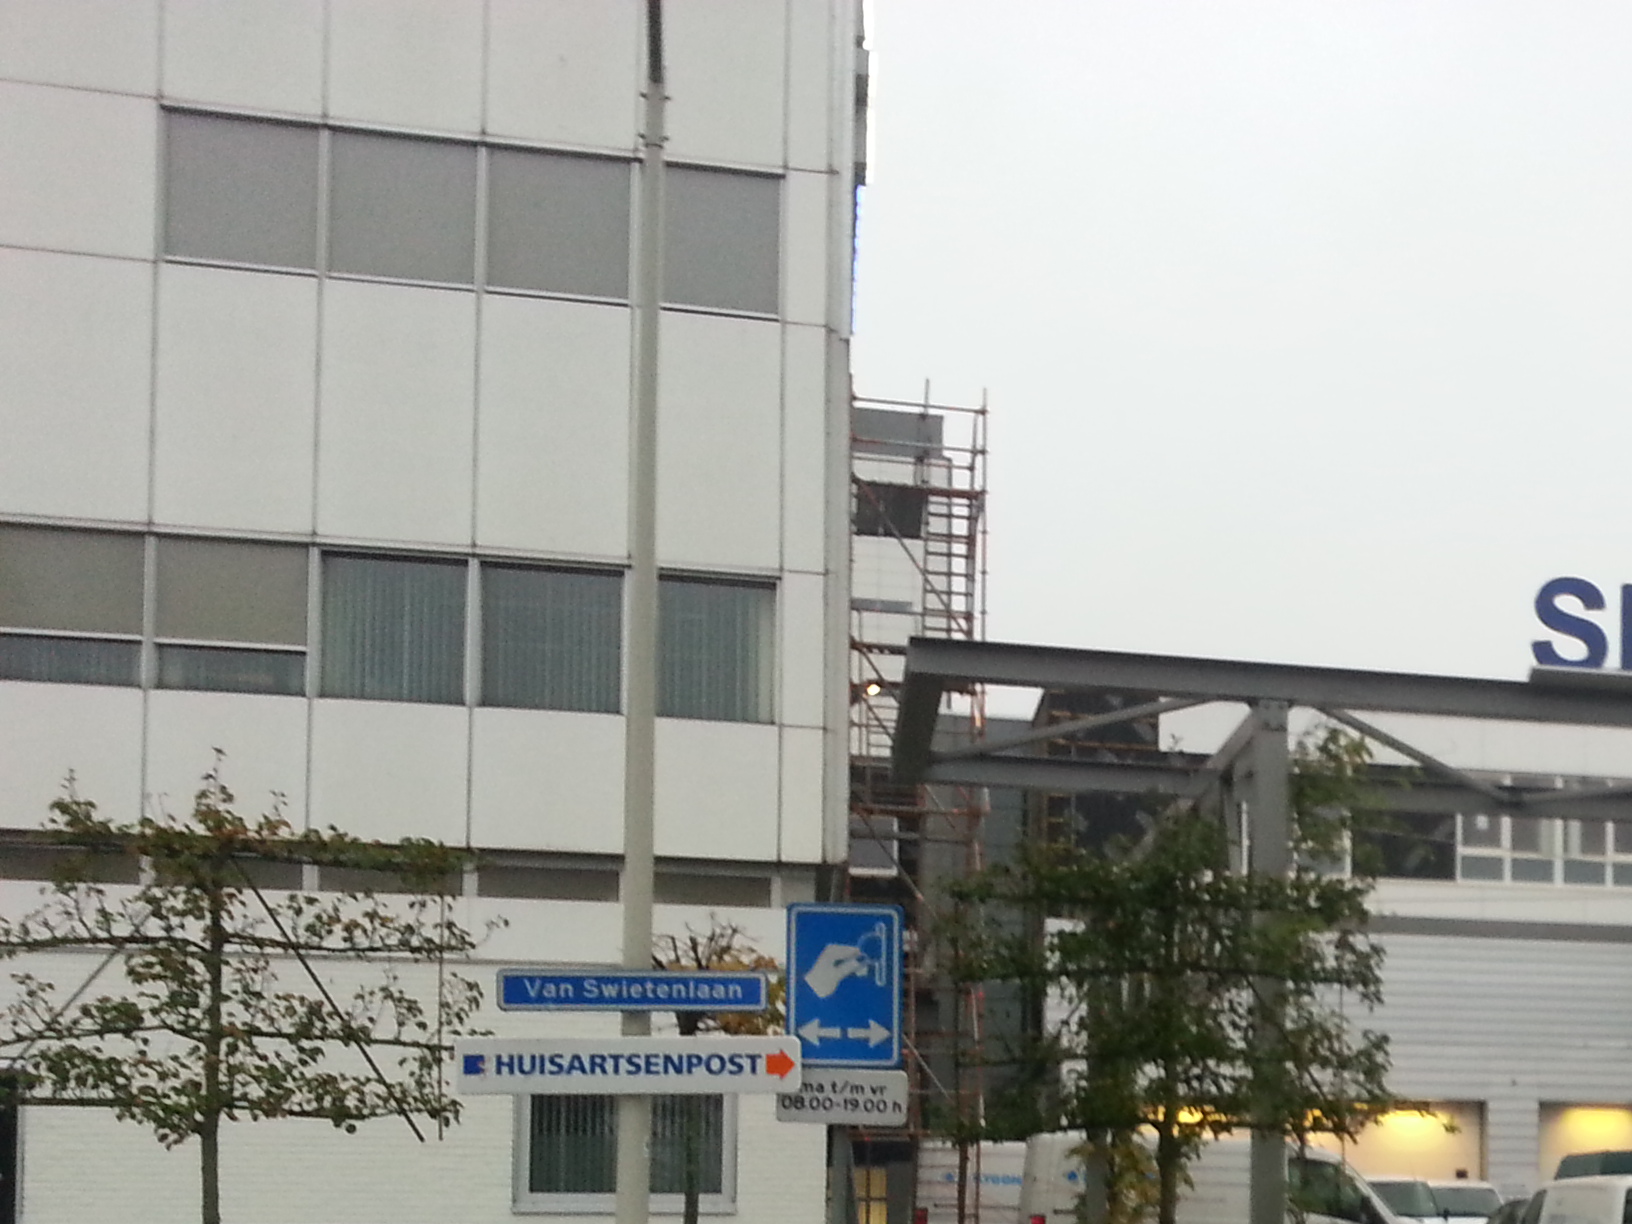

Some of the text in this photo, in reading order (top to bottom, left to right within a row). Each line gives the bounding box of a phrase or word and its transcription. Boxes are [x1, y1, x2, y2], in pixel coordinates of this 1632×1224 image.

[523, 977, 743, 1001] Van Swietenlaan
[494, 1052, 763, 1077] HUISARTSENPOST
[799, 1080, 888, 1096] ma t/m vr
[893, 1100, 903, 1114] h
